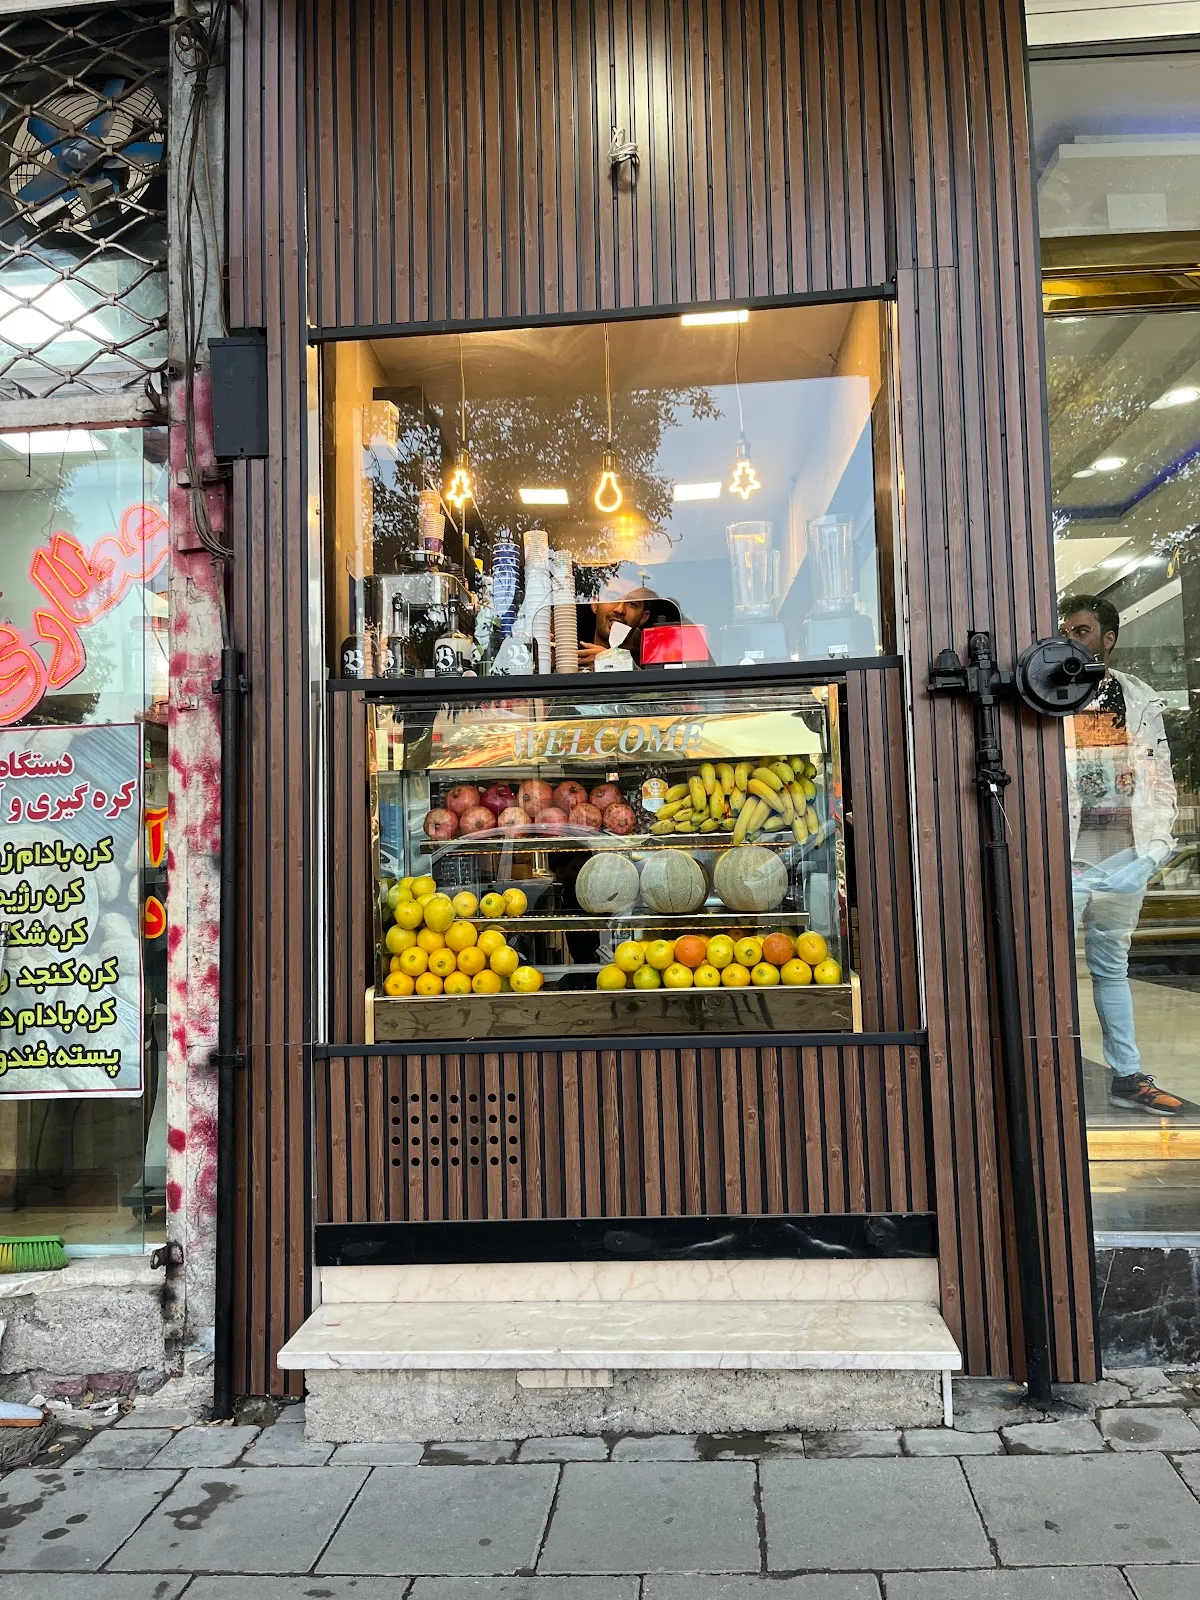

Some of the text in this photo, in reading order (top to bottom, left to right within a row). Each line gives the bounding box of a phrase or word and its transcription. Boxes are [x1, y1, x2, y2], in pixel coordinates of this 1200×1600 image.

[513, 721, 704, 758] WELCOME
[8, 780, 136, 822] کره گیری و
[15, 840, 72, 874] بادام
[74, 836, 113, 870] کره
[45, 877, 85, 913] کره
[48, 917, 88, 952] کره
[17, 958, 76, 994] کنجد
[78, 956, 119, 992] کره
[16, 1001, 74, 1034] بادام
[76, 997, 117, 1033] کره
